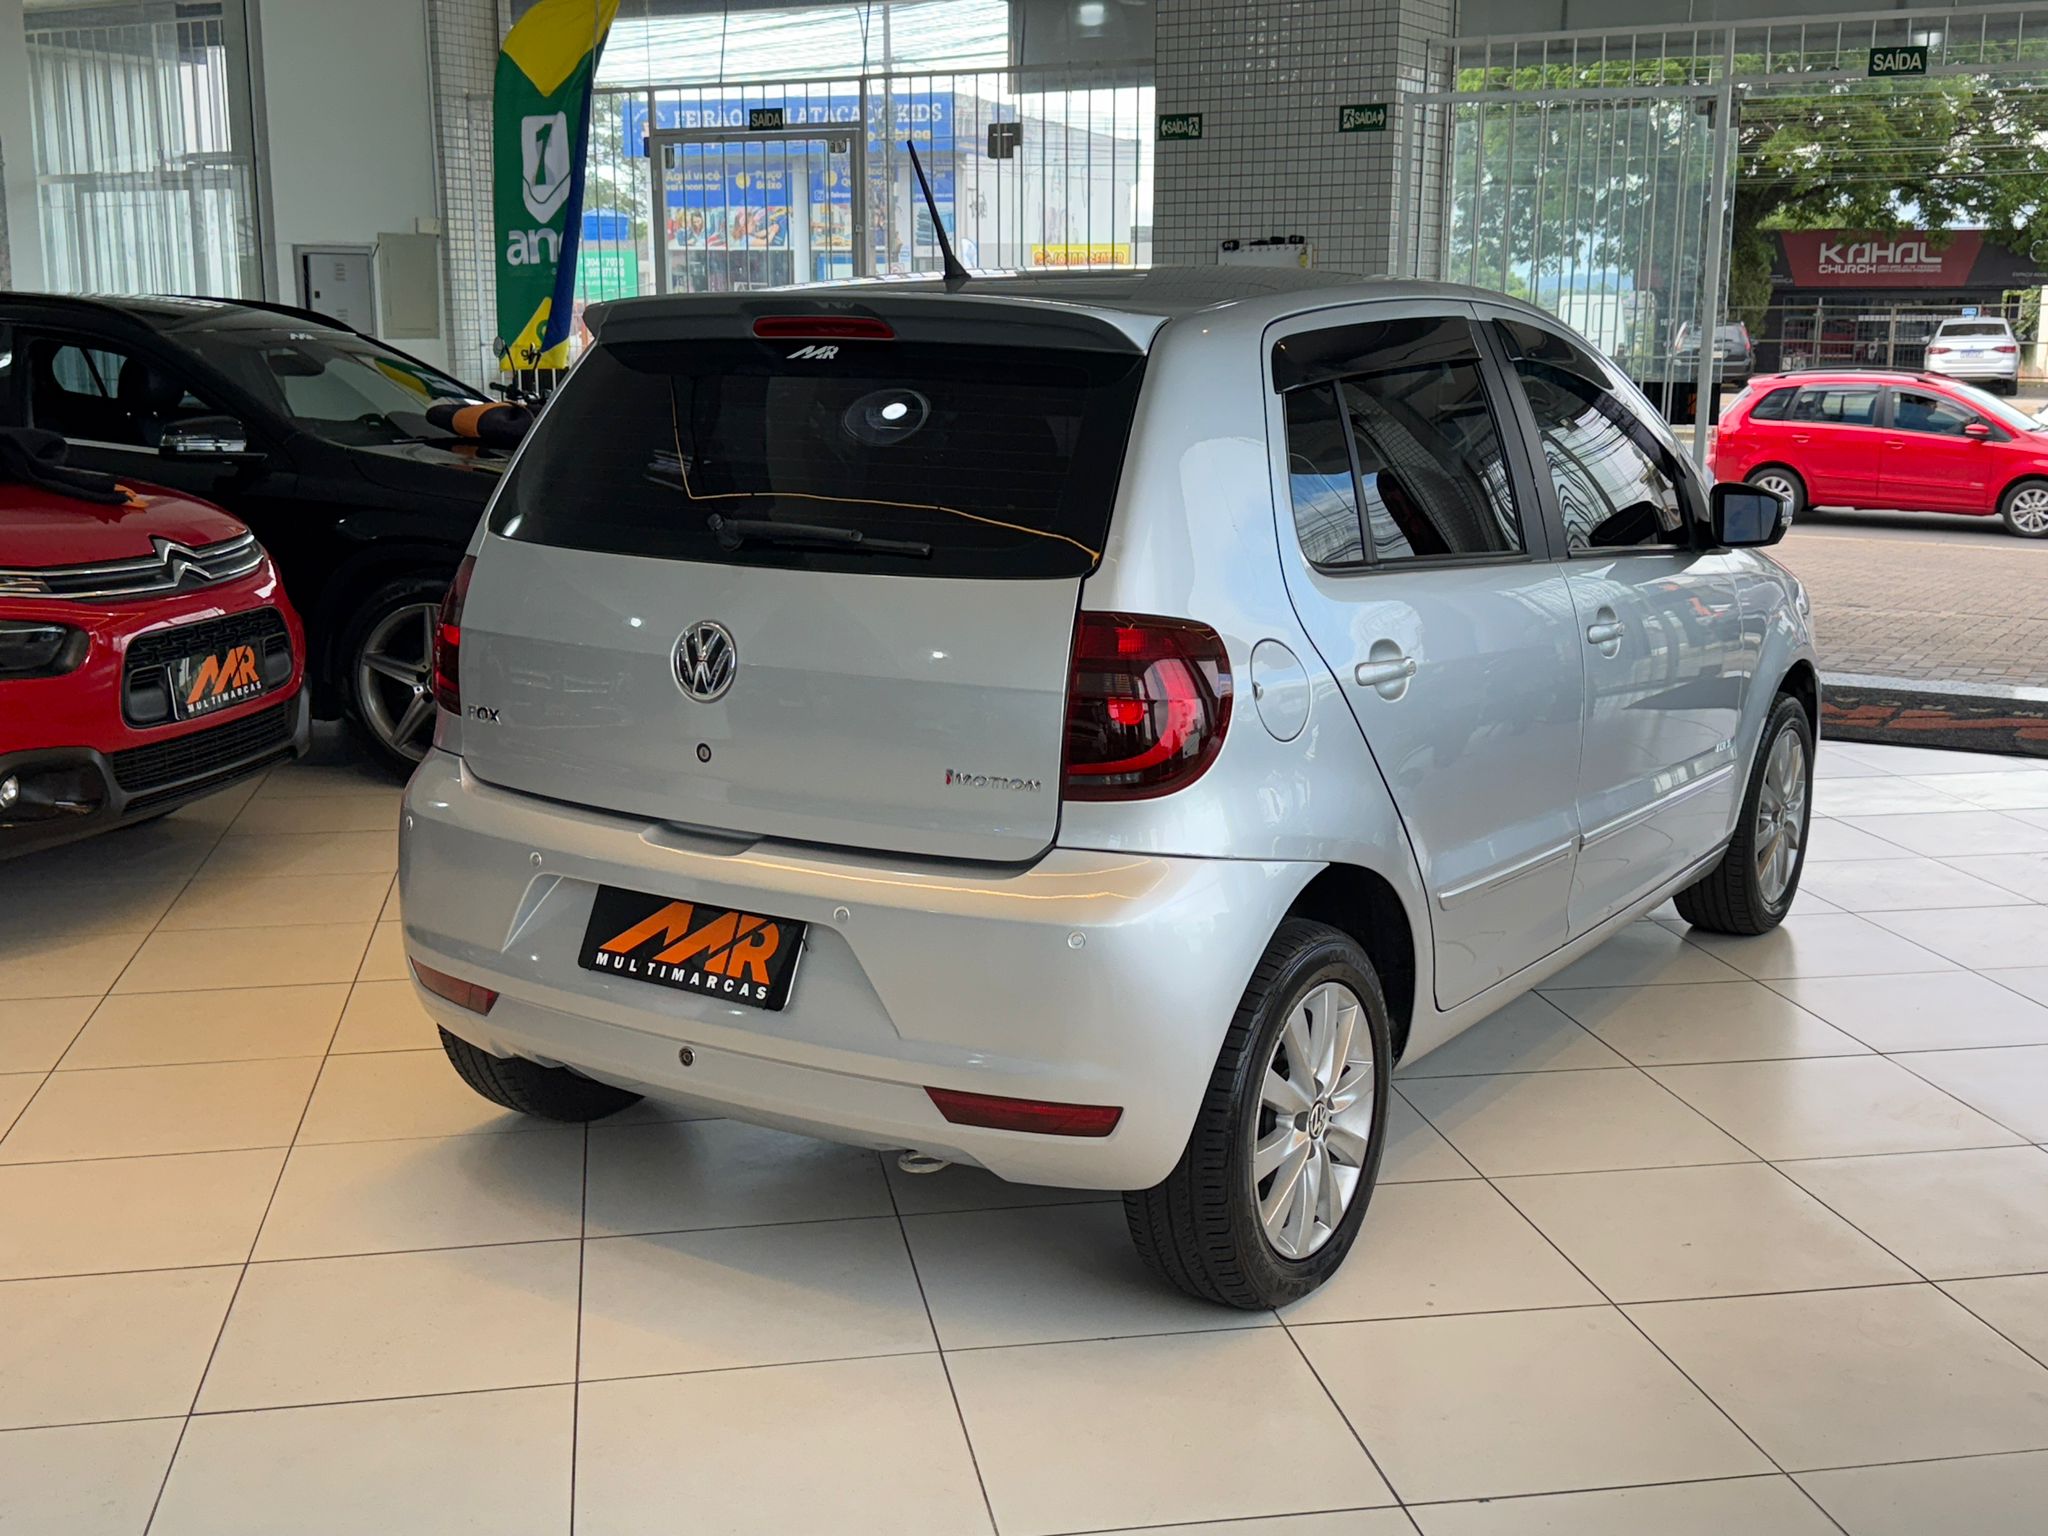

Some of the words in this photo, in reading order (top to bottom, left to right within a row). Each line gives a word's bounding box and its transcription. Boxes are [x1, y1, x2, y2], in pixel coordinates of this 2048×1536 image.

[1872, 49, 1922, 72] SAÍDA
[674, 105, 743, 128] FEIRÃO
[897, 102, 943, 122] KIDS
[751, 111, 781, 128] SAÍDA
[1353, 109, 1378, 125] SAÍDA
[1167, 118, 1189, 134] SAÍDA
[1818, 264, 1877, 274] CHURCH
[187, 681, 262, 713] MULTIMARCAS
[467, 704, 501, 725] FOX
[595, 951, 769, 1001] MULTIMARCAS
